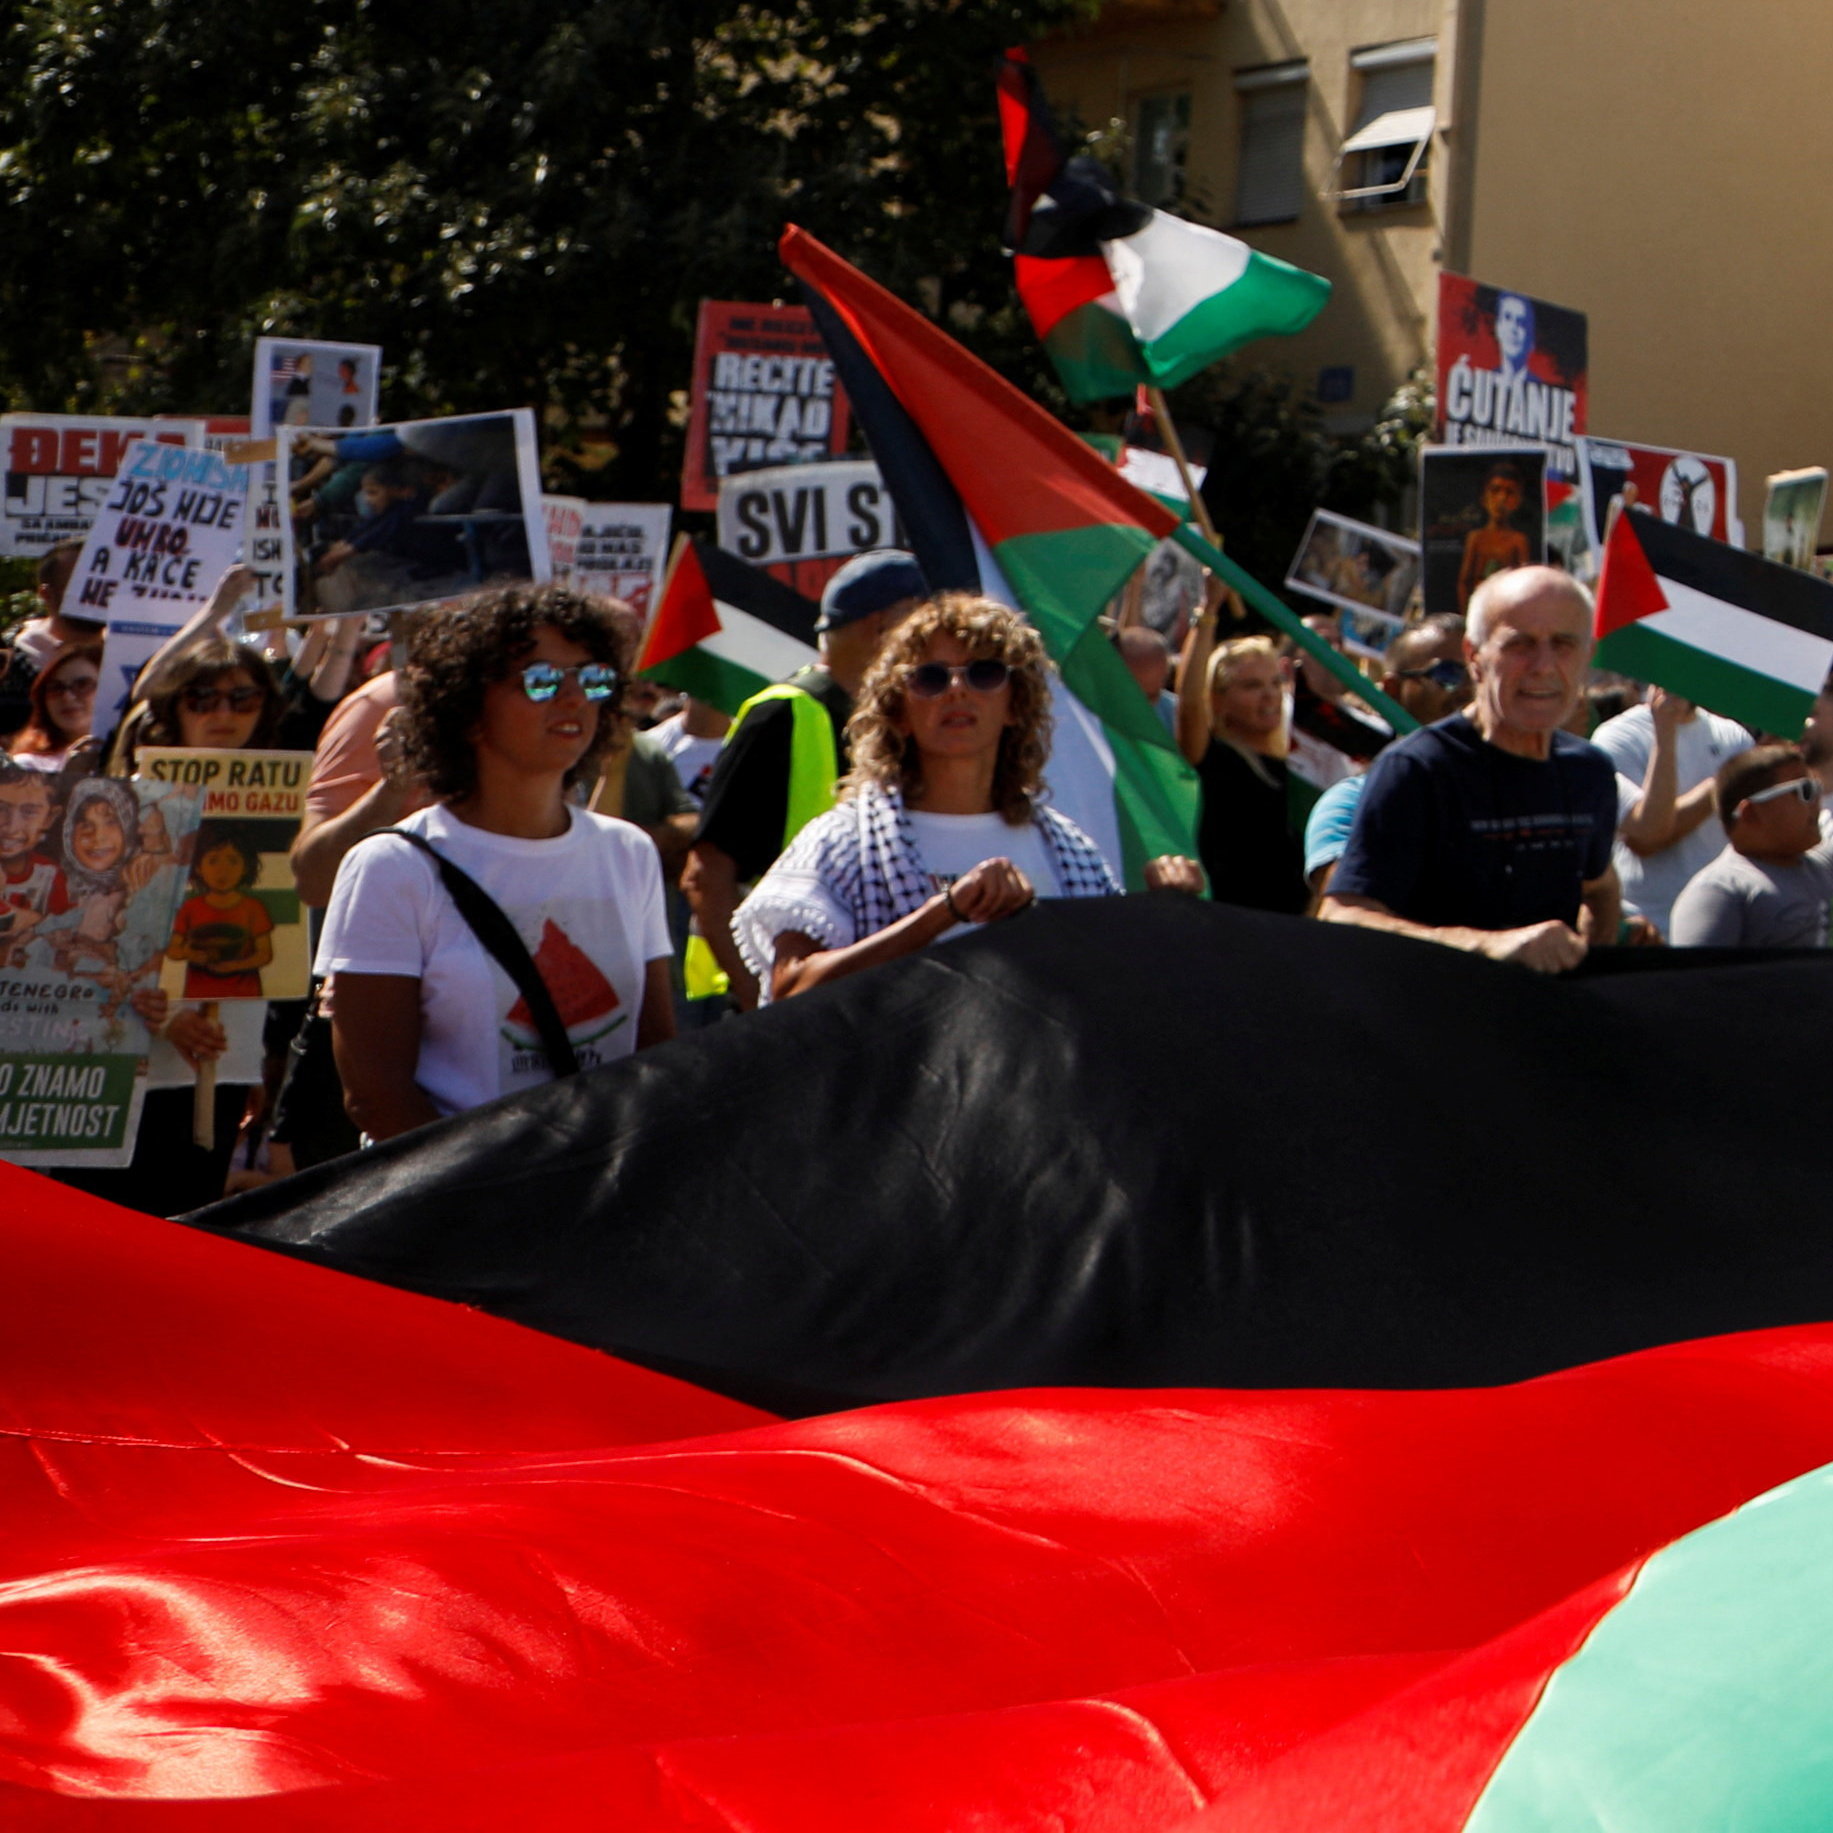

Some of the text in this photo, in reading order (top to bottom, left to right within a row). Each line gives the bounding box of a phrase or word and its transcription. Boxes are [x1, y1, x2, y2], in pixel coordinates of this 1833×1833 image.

[1447, 354, 1576, 447] ĆUTANJE
[738, 485, 827, 559] SVI
[89, 547, 112, 574] A
[151, 759, 301, 787] STOP RATU
[245, 792, 298, 812] GAZU
[17, 1063, 106, 1099] ZNAMO
